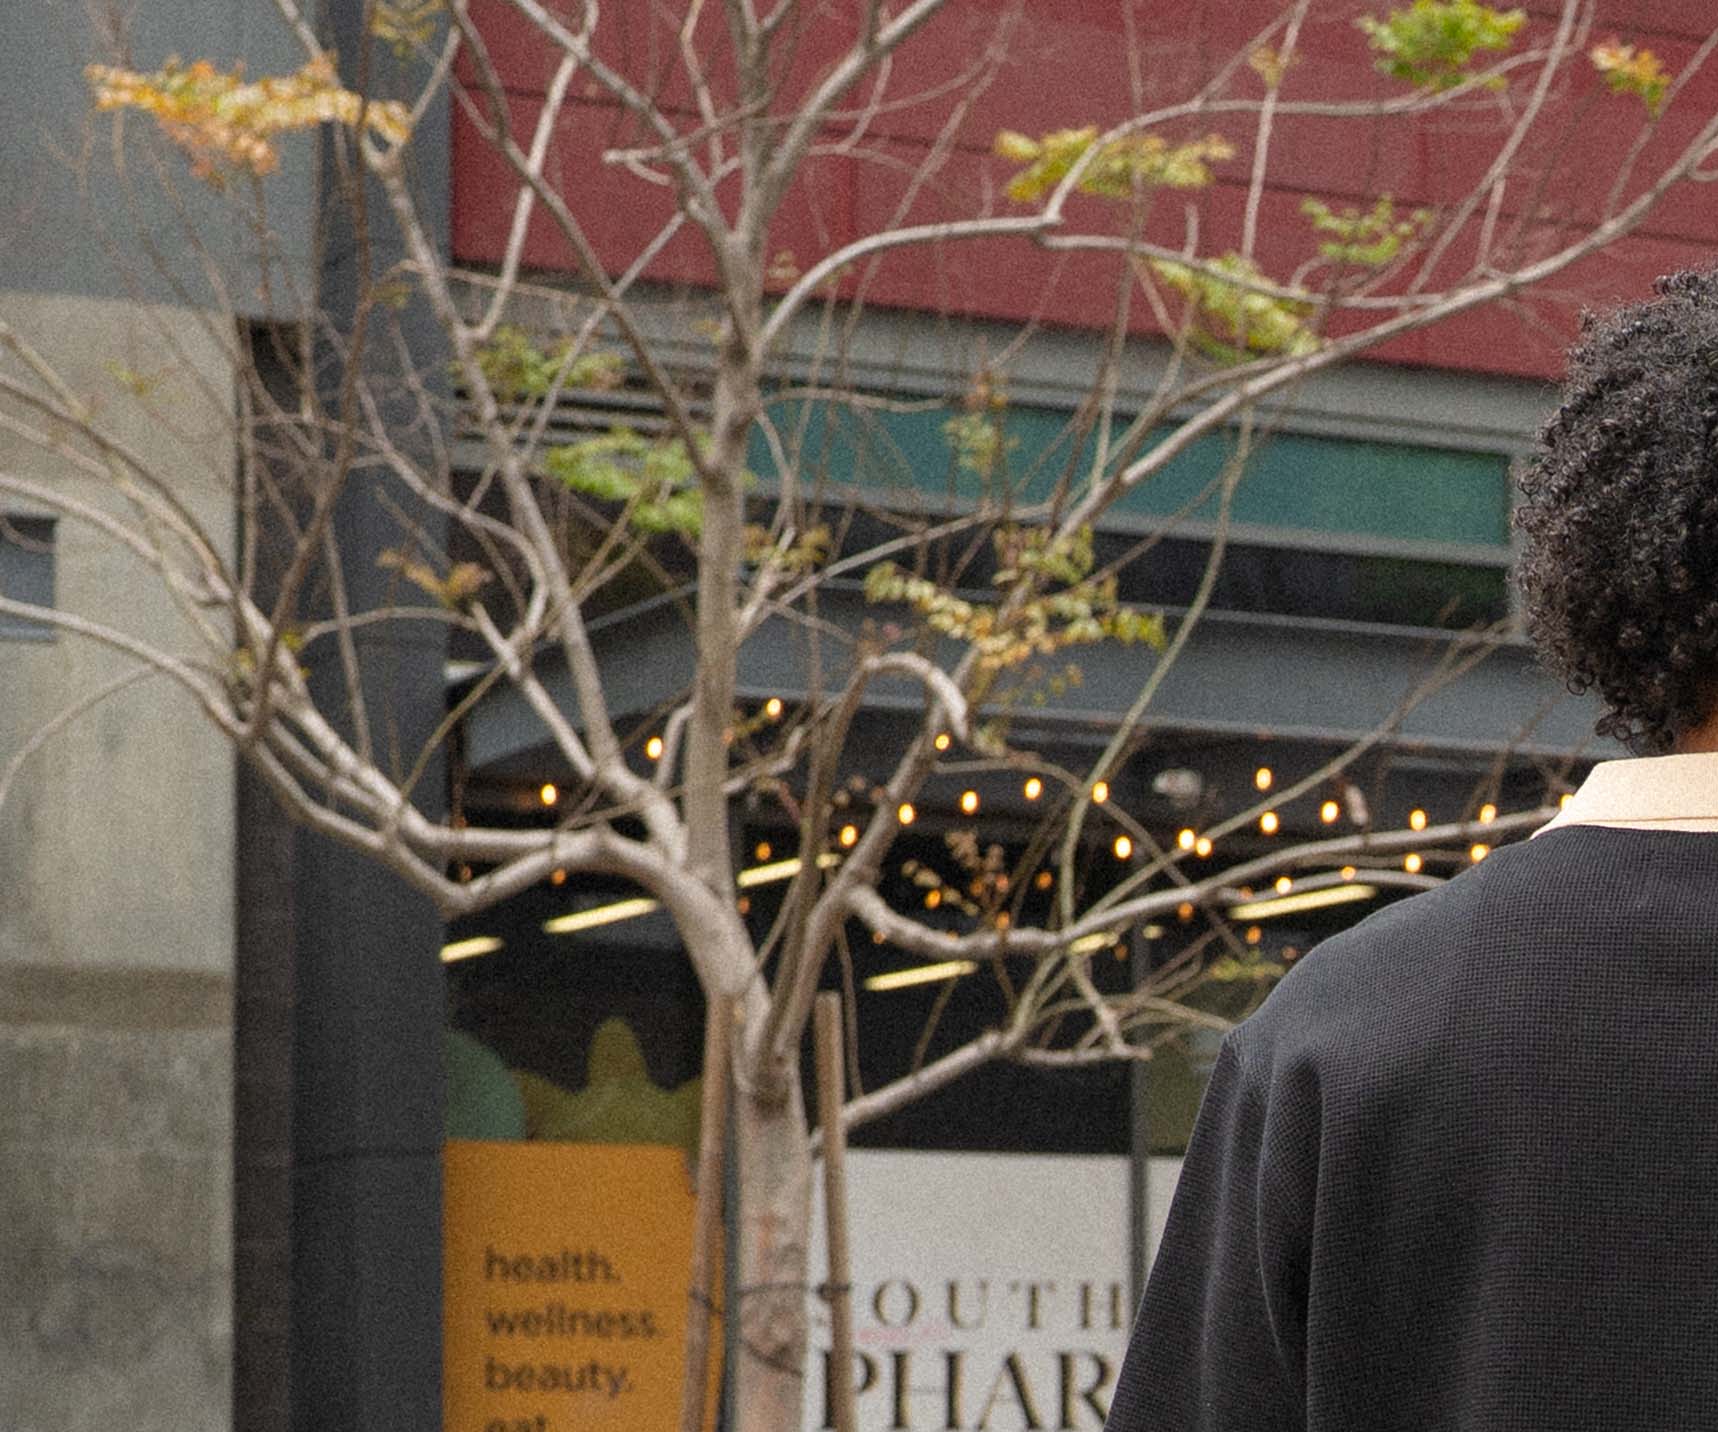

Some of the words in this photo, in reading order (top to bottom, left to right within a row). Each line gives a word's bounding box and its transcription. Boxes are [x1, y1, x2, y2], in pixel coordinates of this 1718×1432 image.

[484, 1245, 624, 1281] health.
[485, 1302, 670, 1339] wellness.
[820, 1279, 1123, 1331] OUTH
[484, 1356, 636, 1400] beauty.
